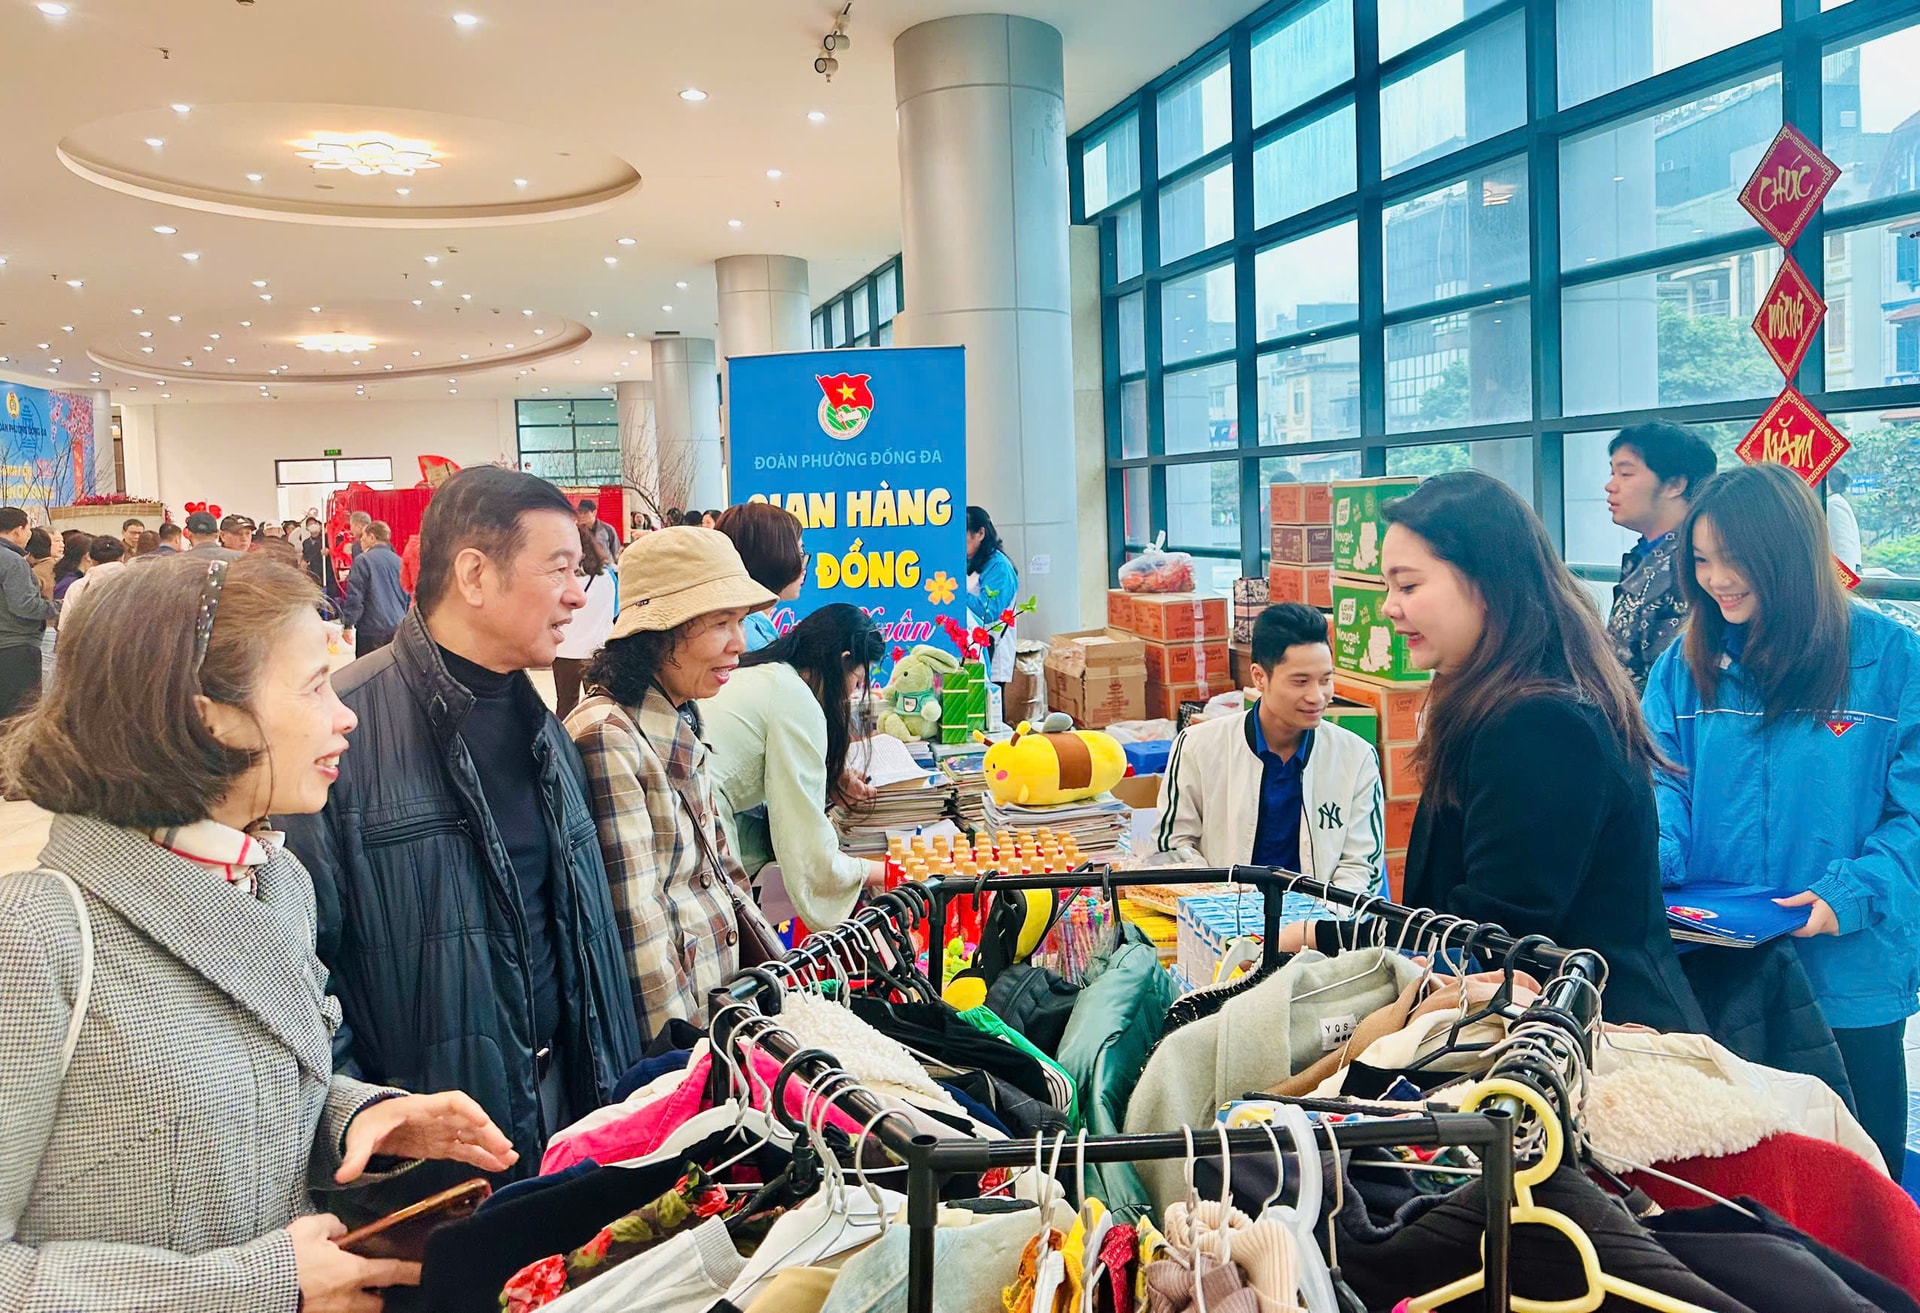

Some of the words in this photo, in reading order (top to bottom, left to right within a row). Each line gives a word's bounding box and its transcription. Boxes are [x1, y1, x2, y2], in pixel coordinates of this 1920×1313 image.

[1759, 155, 1813, 212] CHÚC
[754, 453, 798, 470] ĐOÀN
[802, 450, 867, 468] PHƯỜNG
[870, 447, 916, 465] ĐỐNG
[919, 449, 943, 464] ĐA
[1762, 415, 1815, 469] NĂM
[748, 491, 837, 529] AN
[846, 480, 952, 528] HÀNG
[1318, 802, 1344, 830] NY
